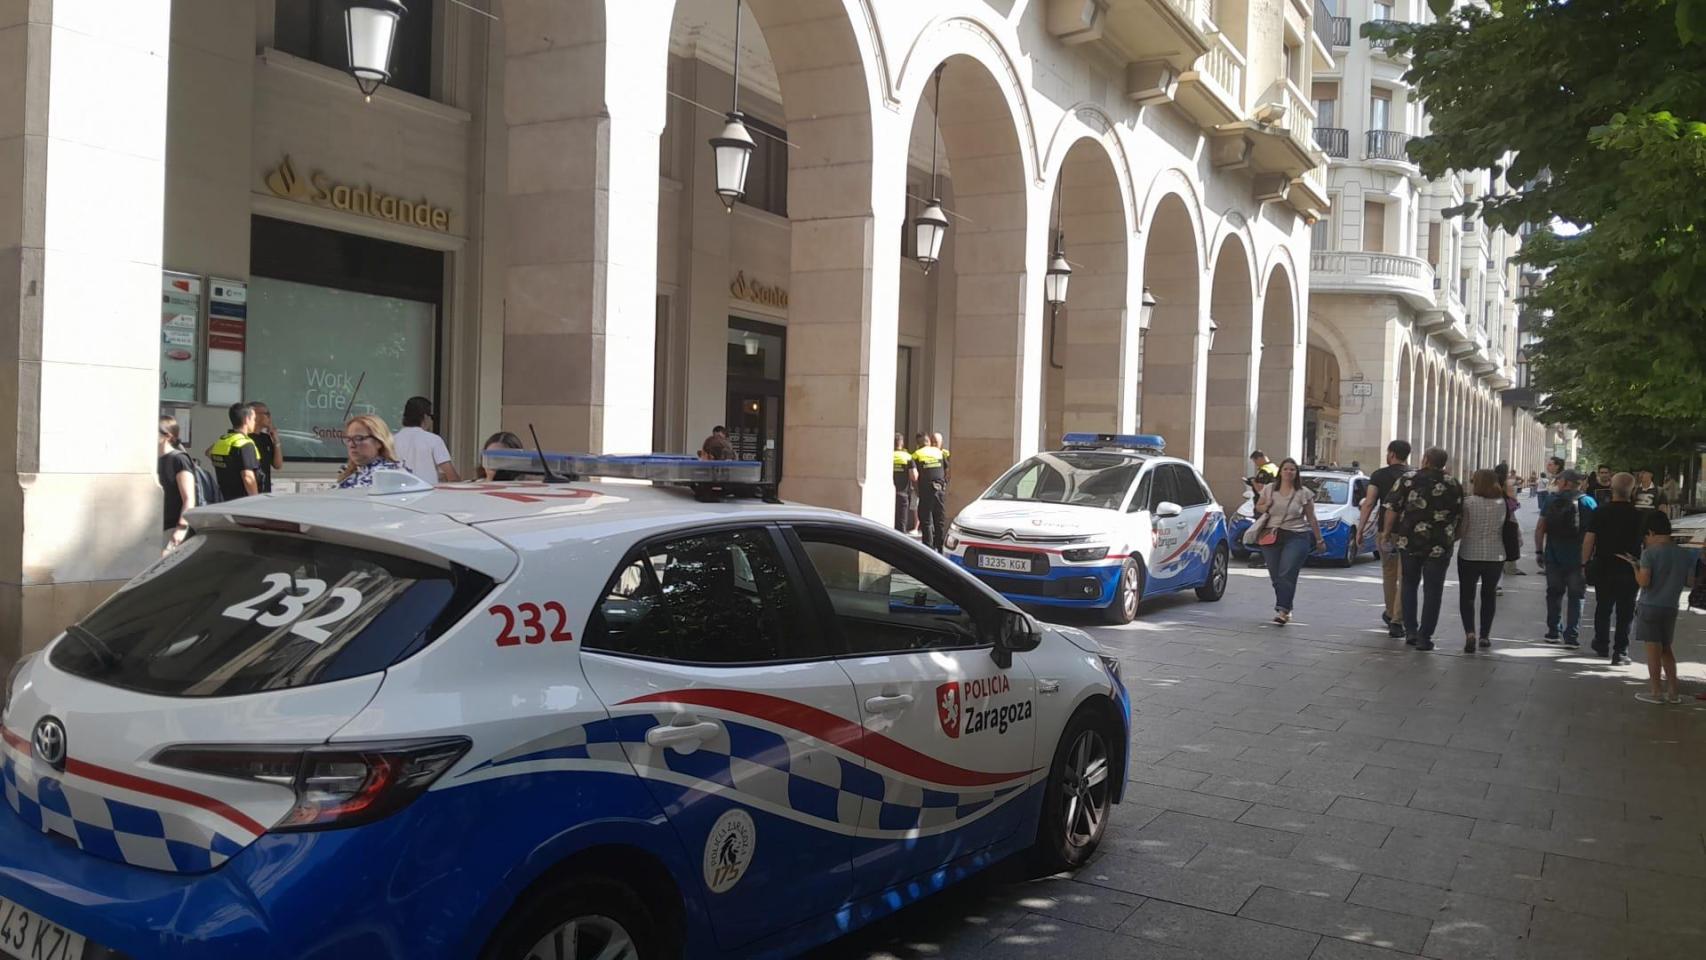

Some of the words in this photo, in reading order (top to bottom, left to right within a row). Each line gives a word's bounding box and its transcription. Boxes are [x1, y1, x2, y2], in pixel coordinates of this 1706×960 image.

[305, 367, 354, 392] Work
[305, 389, 346, 410] Café
[984, 558, 1007, 569] 3235
[1009, 560, 1027, 570] KGX
[221, 572, 363, 645] 232
[488, 600, 573, 647] 232
[964, 674, 1010, 701] POLICIA
[965, 700, 1032, 735] Zaragoza
[712, 862, 741, 888] 175
